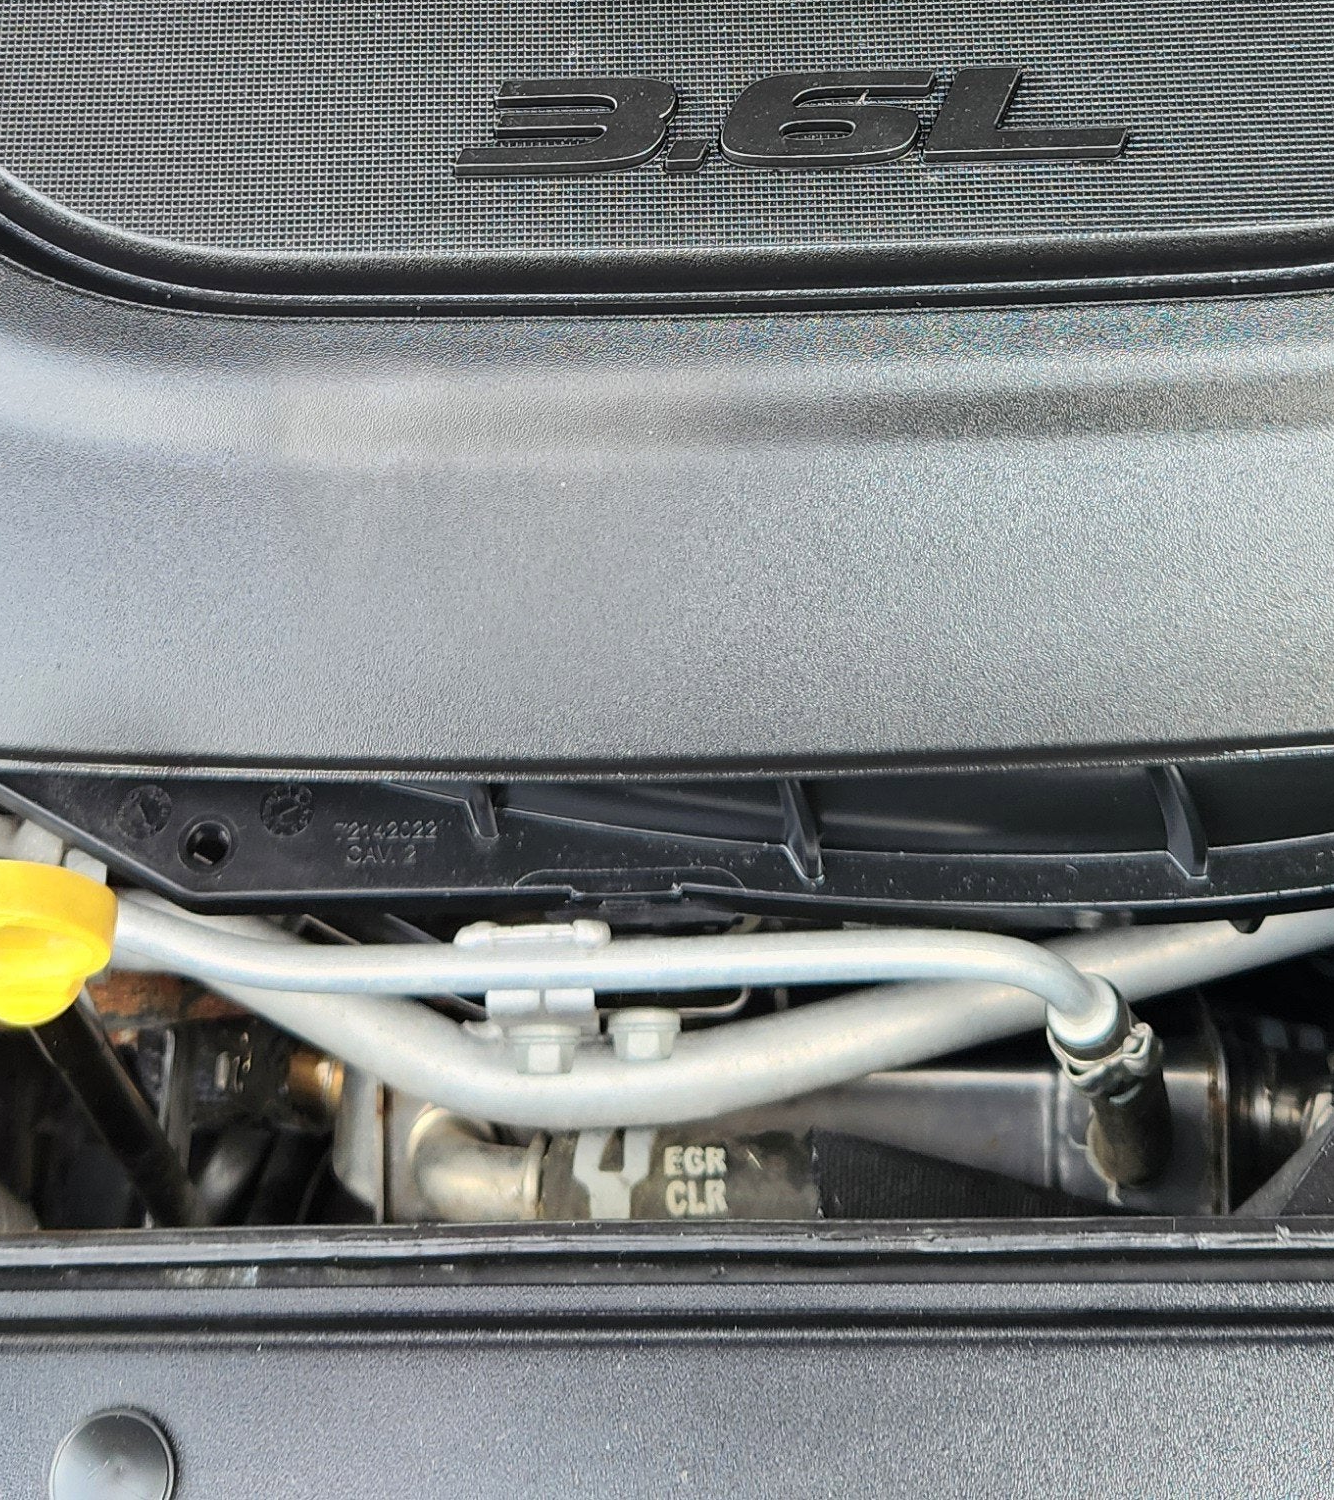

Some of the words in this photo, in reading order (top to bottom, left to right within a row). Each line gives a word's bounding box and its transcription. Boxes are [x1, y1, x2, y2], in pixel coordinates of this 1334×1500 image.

[455, 66, 1129, 178] 3.6L
[664, 1145, 727, 1177] EGR
[665, 1179, 728, 1215] CLR
